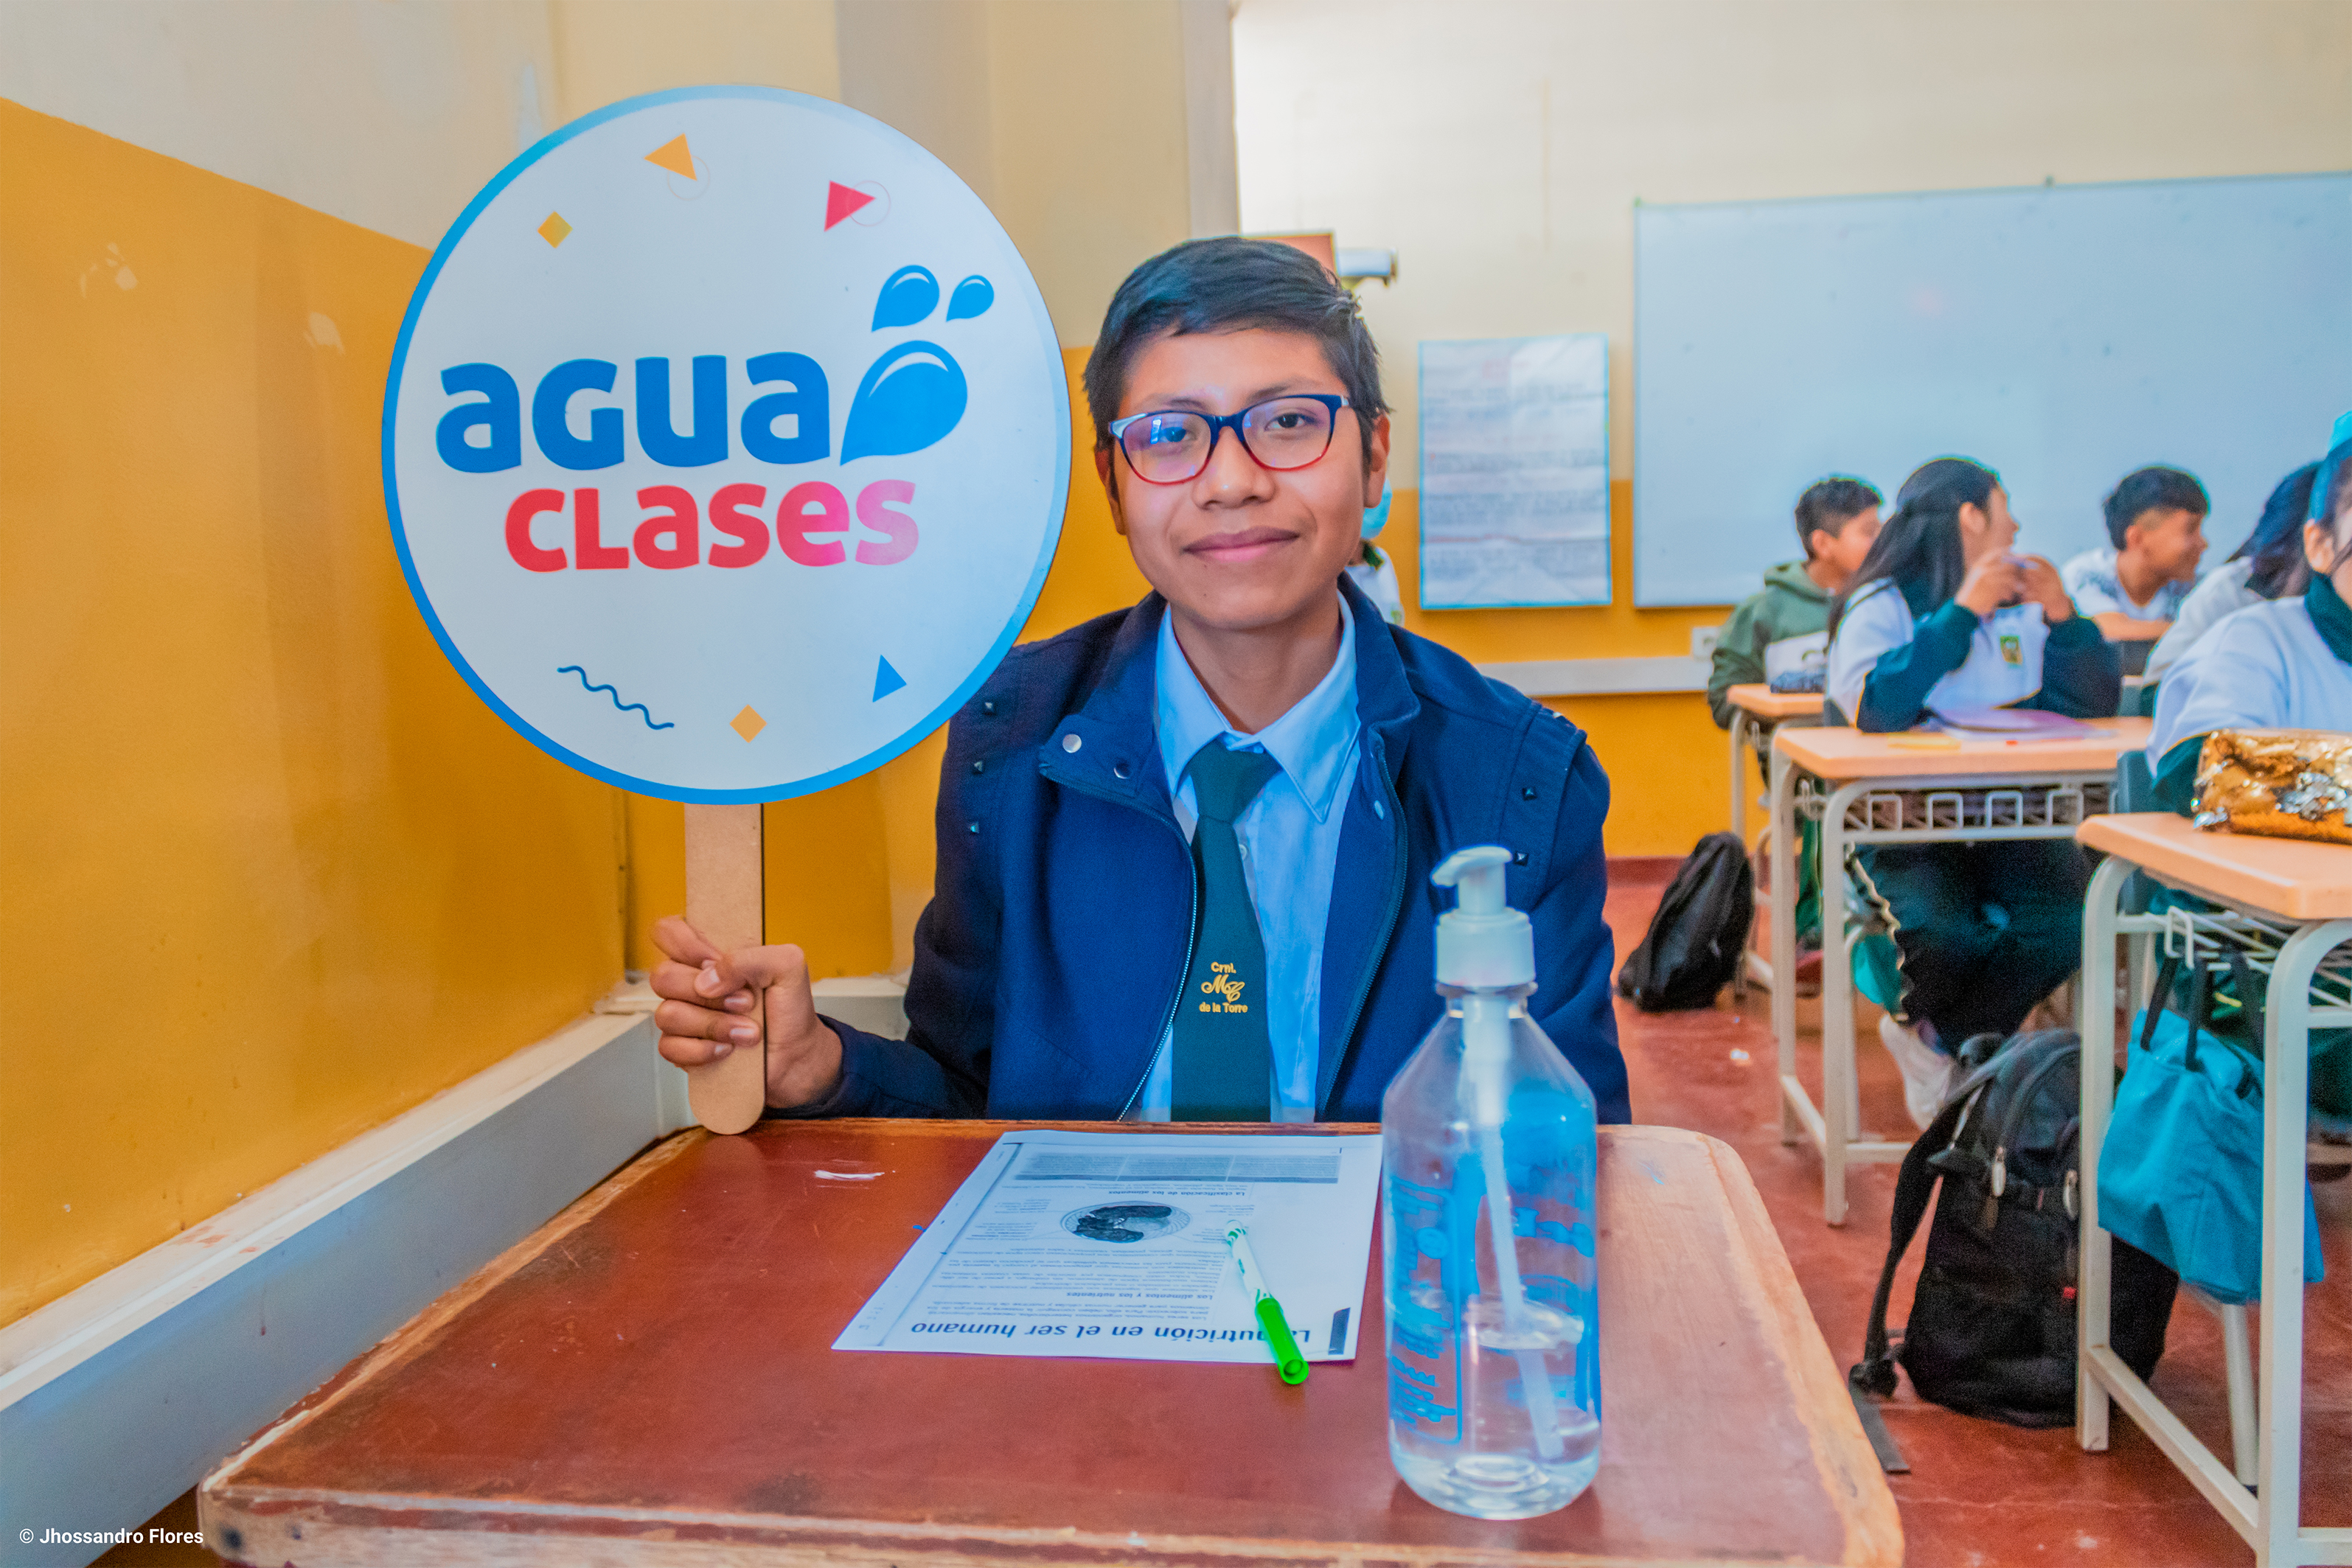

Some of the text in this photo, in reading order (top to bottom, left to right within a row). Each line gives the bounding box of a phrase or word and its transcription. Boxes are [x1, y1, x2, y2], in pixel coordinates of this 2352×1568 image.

[1199, 1001, 1248, 1014] de la Torre
[911, 1323, 1017, 1338] humano
[1024, 1325, 1068, 1336] ser
[1076, 1325, 1102, 1338] el
[1111, 1325, 1144, 1337] en
